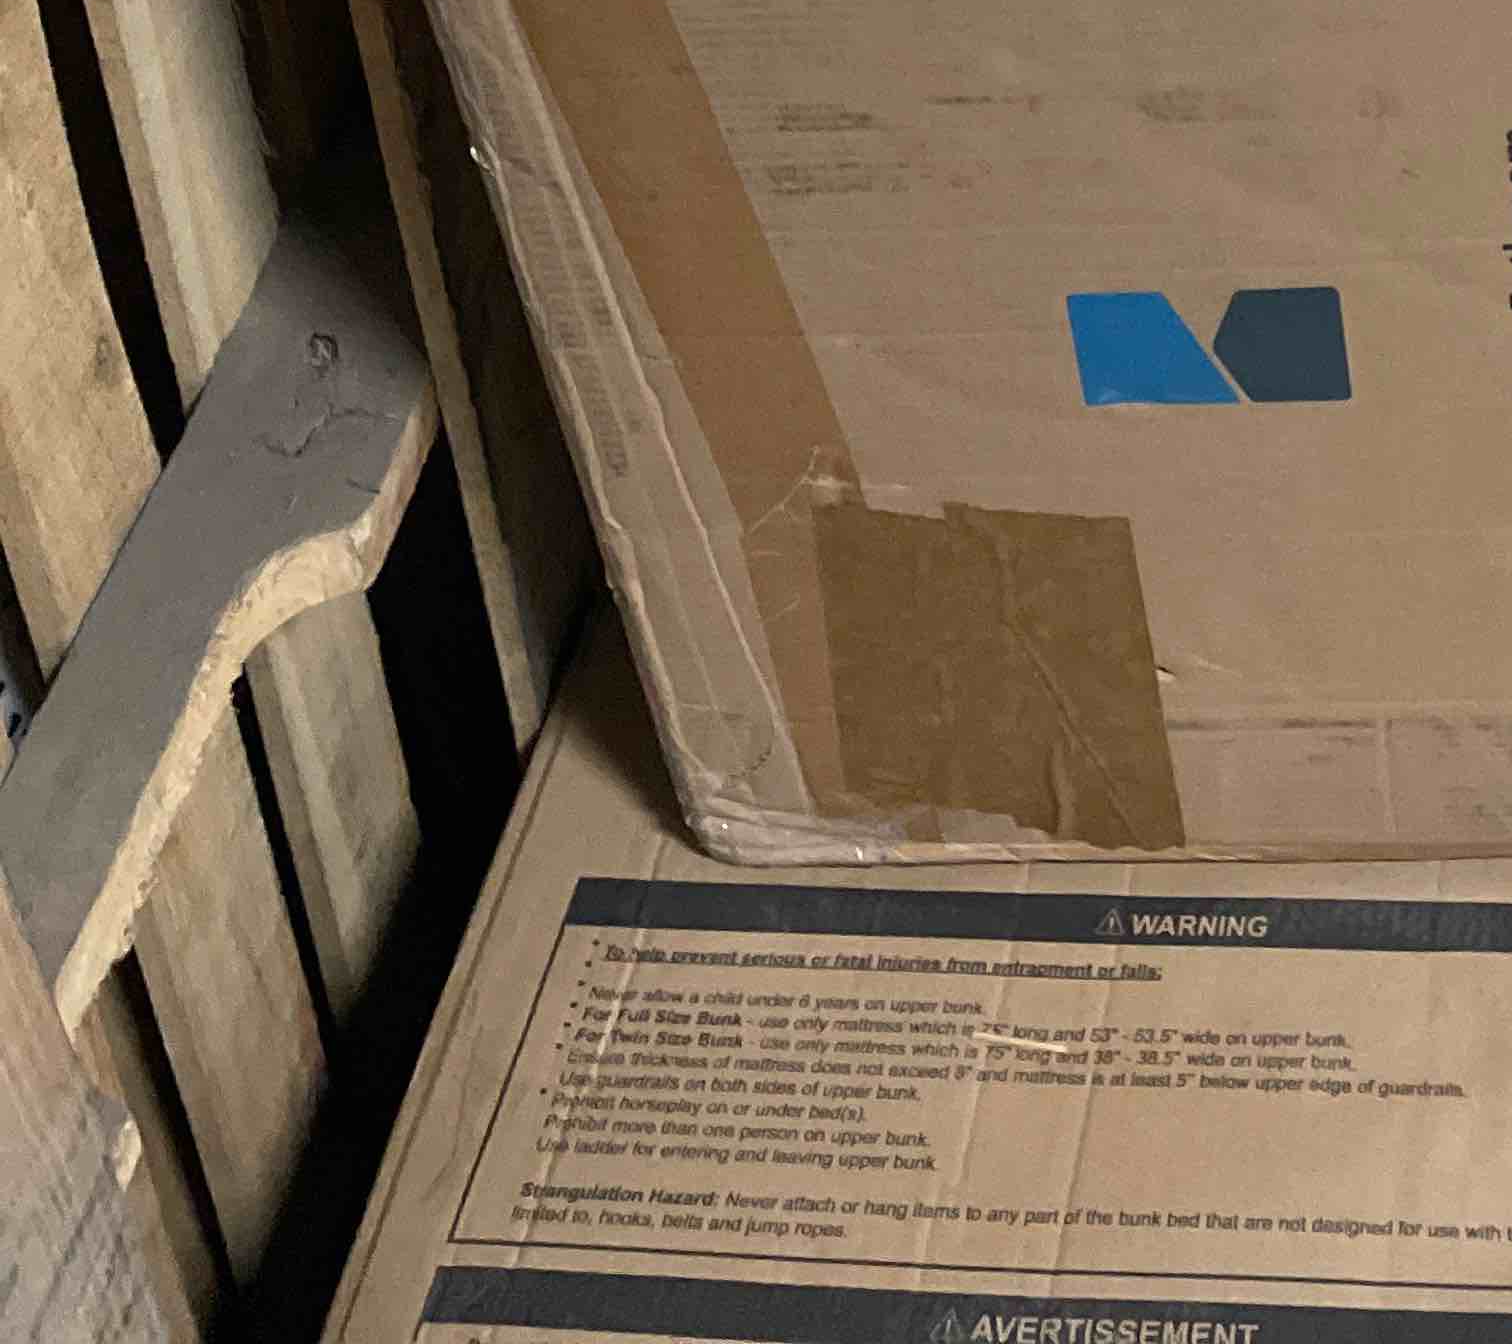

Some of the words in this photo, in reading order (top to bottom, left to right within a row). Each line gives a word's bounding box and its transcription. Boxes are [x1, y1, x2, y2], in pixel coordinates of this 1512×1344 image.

[1132, 914, 1269, 939] WARNING
[726, 1192, 777, 1210] Never
[864, 1200, 908, 1220] hang
[970, 1314, 1260, 1344] AVERTISSEMENT
